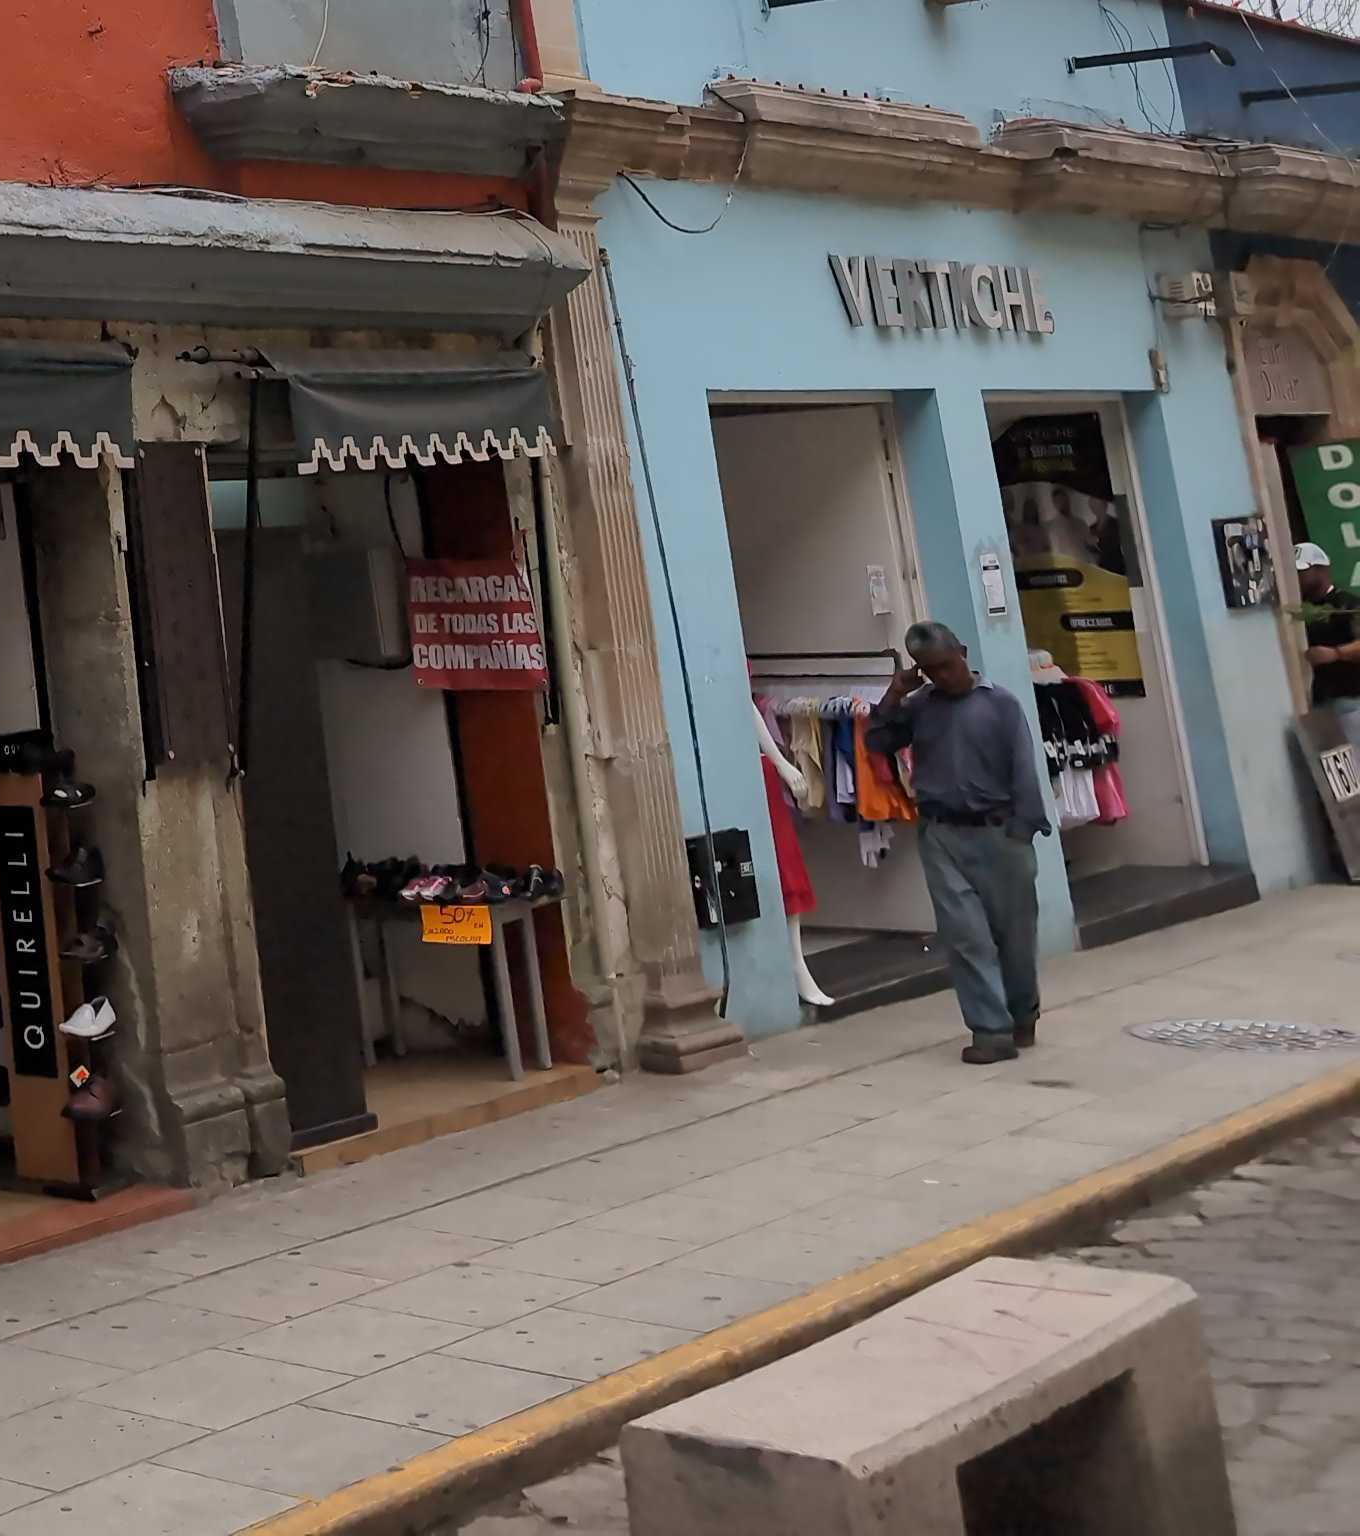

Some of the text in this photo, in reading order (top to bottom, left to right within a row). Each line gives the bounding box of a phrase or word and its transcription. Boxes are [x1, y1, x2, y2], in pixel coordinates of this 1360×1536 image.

[410, 575, 532, 603] RECARGAS
[415, 612, 537, 634] DE TODAS LAS
[412, 639, 546, 671] COMPAÑÍAS
[4, 831, 45, 1050] QUIRELLI
